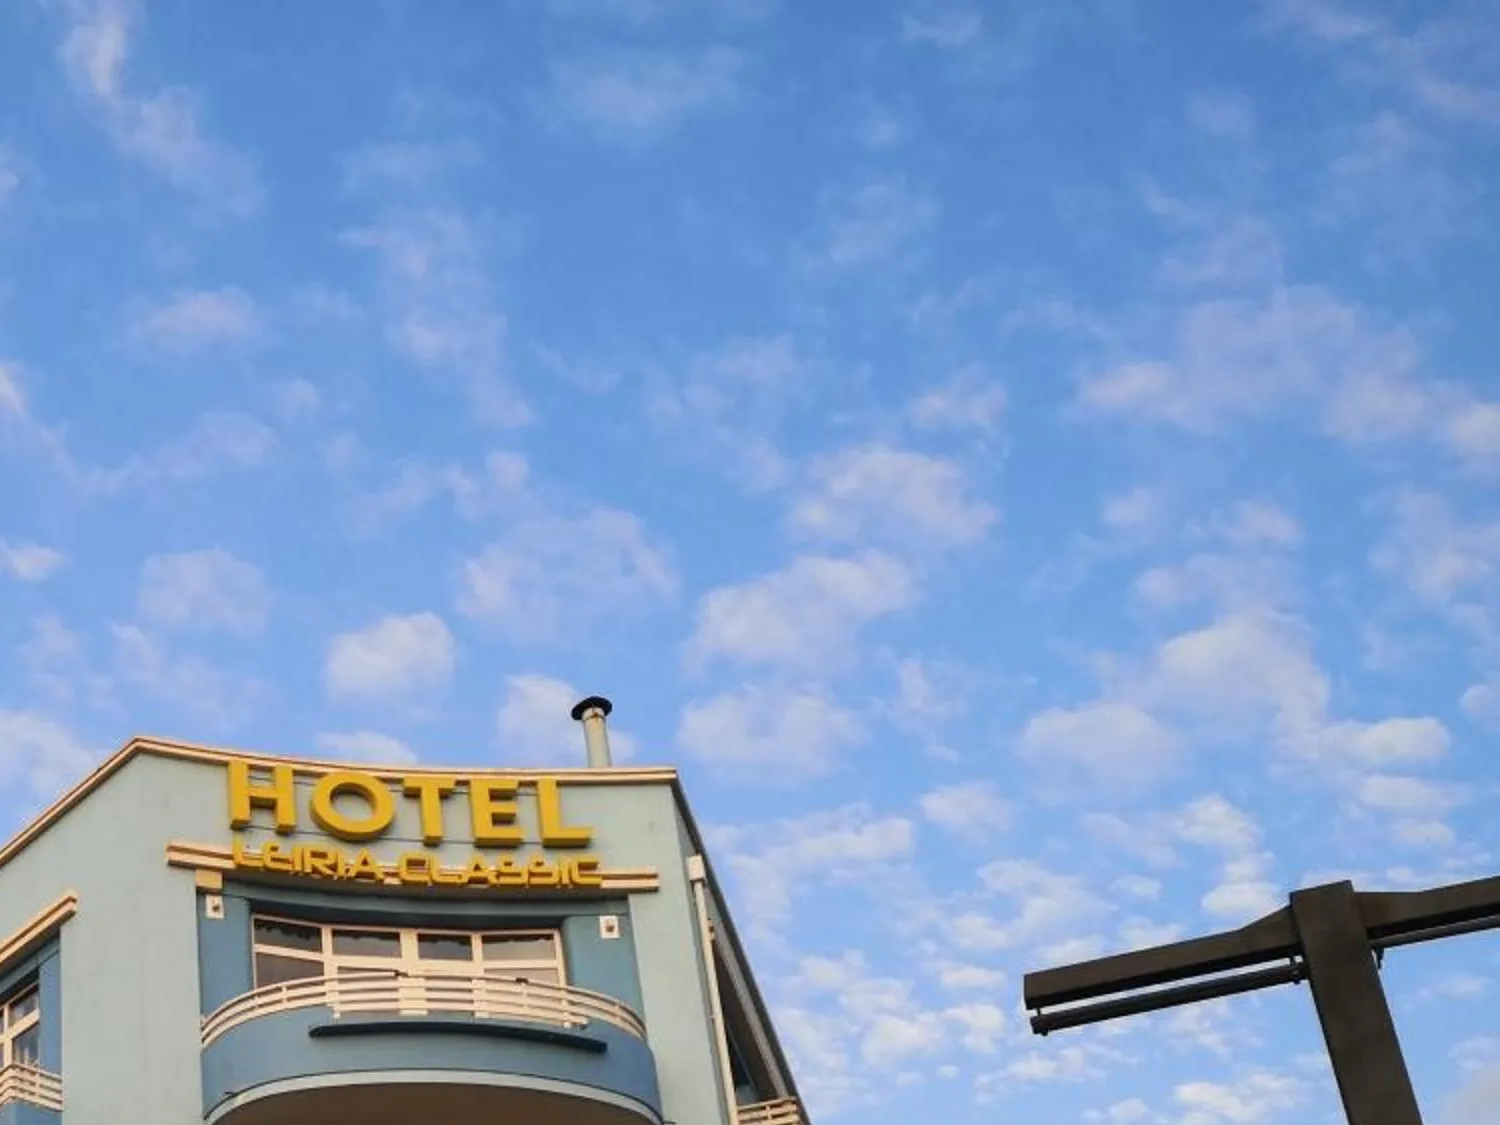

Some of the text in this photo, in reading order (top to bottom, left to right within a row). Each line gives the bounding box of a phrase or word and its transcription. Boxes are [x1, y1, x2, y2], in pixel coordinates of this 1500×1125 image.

[227, 760, 594, 849] HOTEL
[232, 836, 602, 886] LEIRIA CLASSIC
